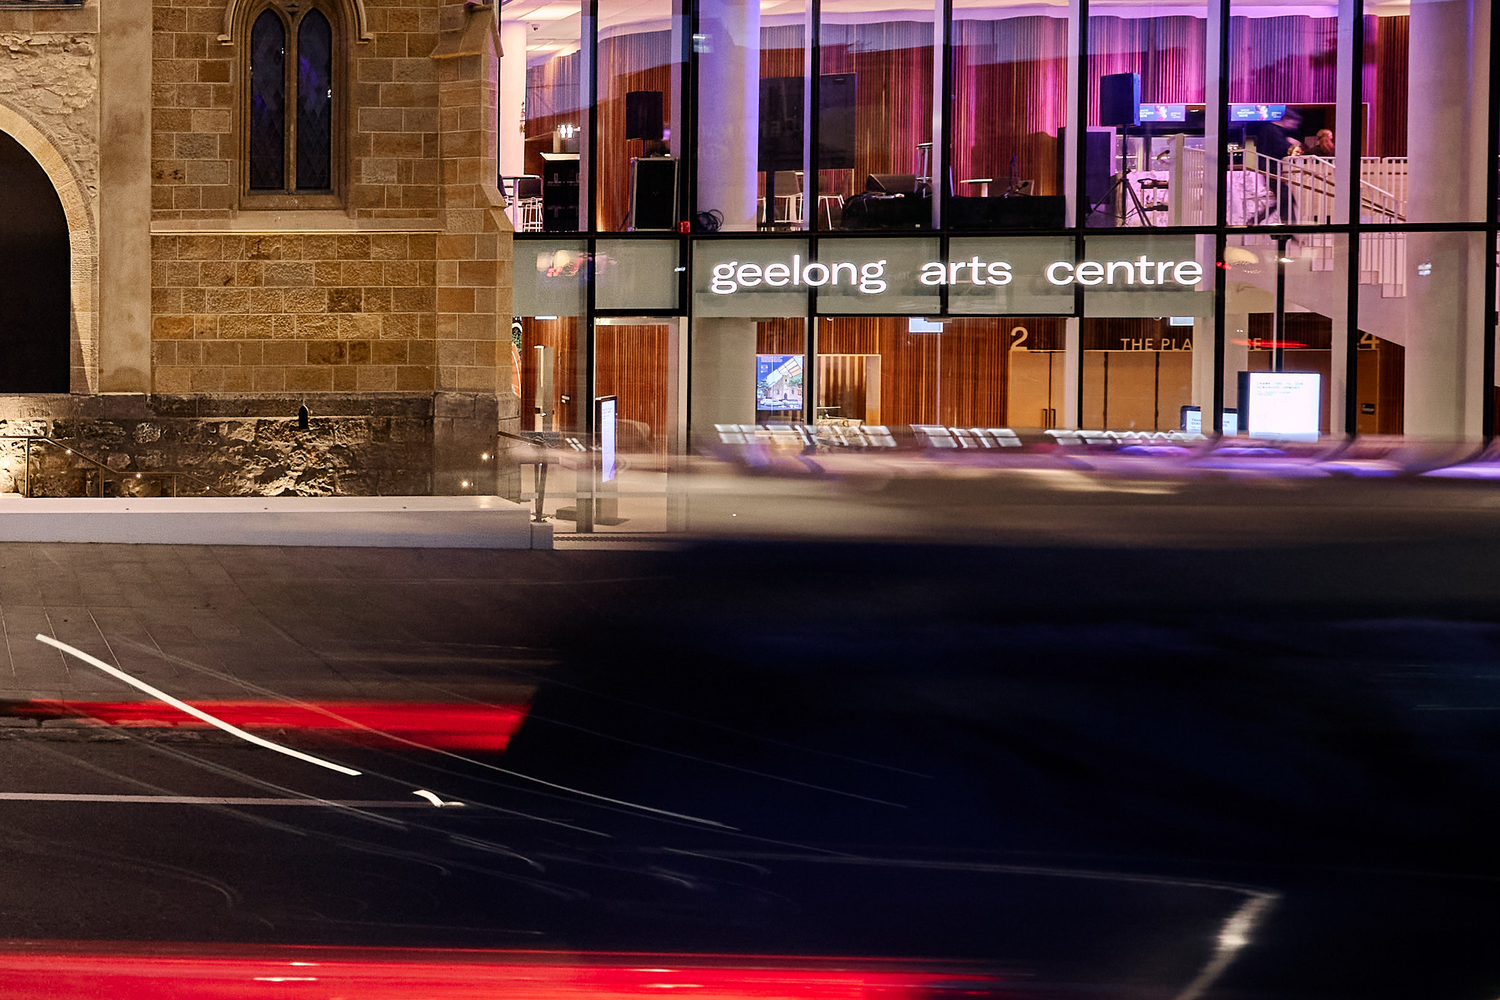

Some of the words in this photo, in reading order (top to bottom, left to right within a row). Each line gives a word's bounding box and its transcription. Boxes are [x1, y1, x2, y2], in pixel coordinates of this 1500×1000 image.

[711, 254, 888, 295] geelong
[920, 254, 1013, 286] arts
[1046, 254, 1204, 286] centre
[1010, 326, 1029, 350] 2
[1120, 338, 1154, 351] THE
